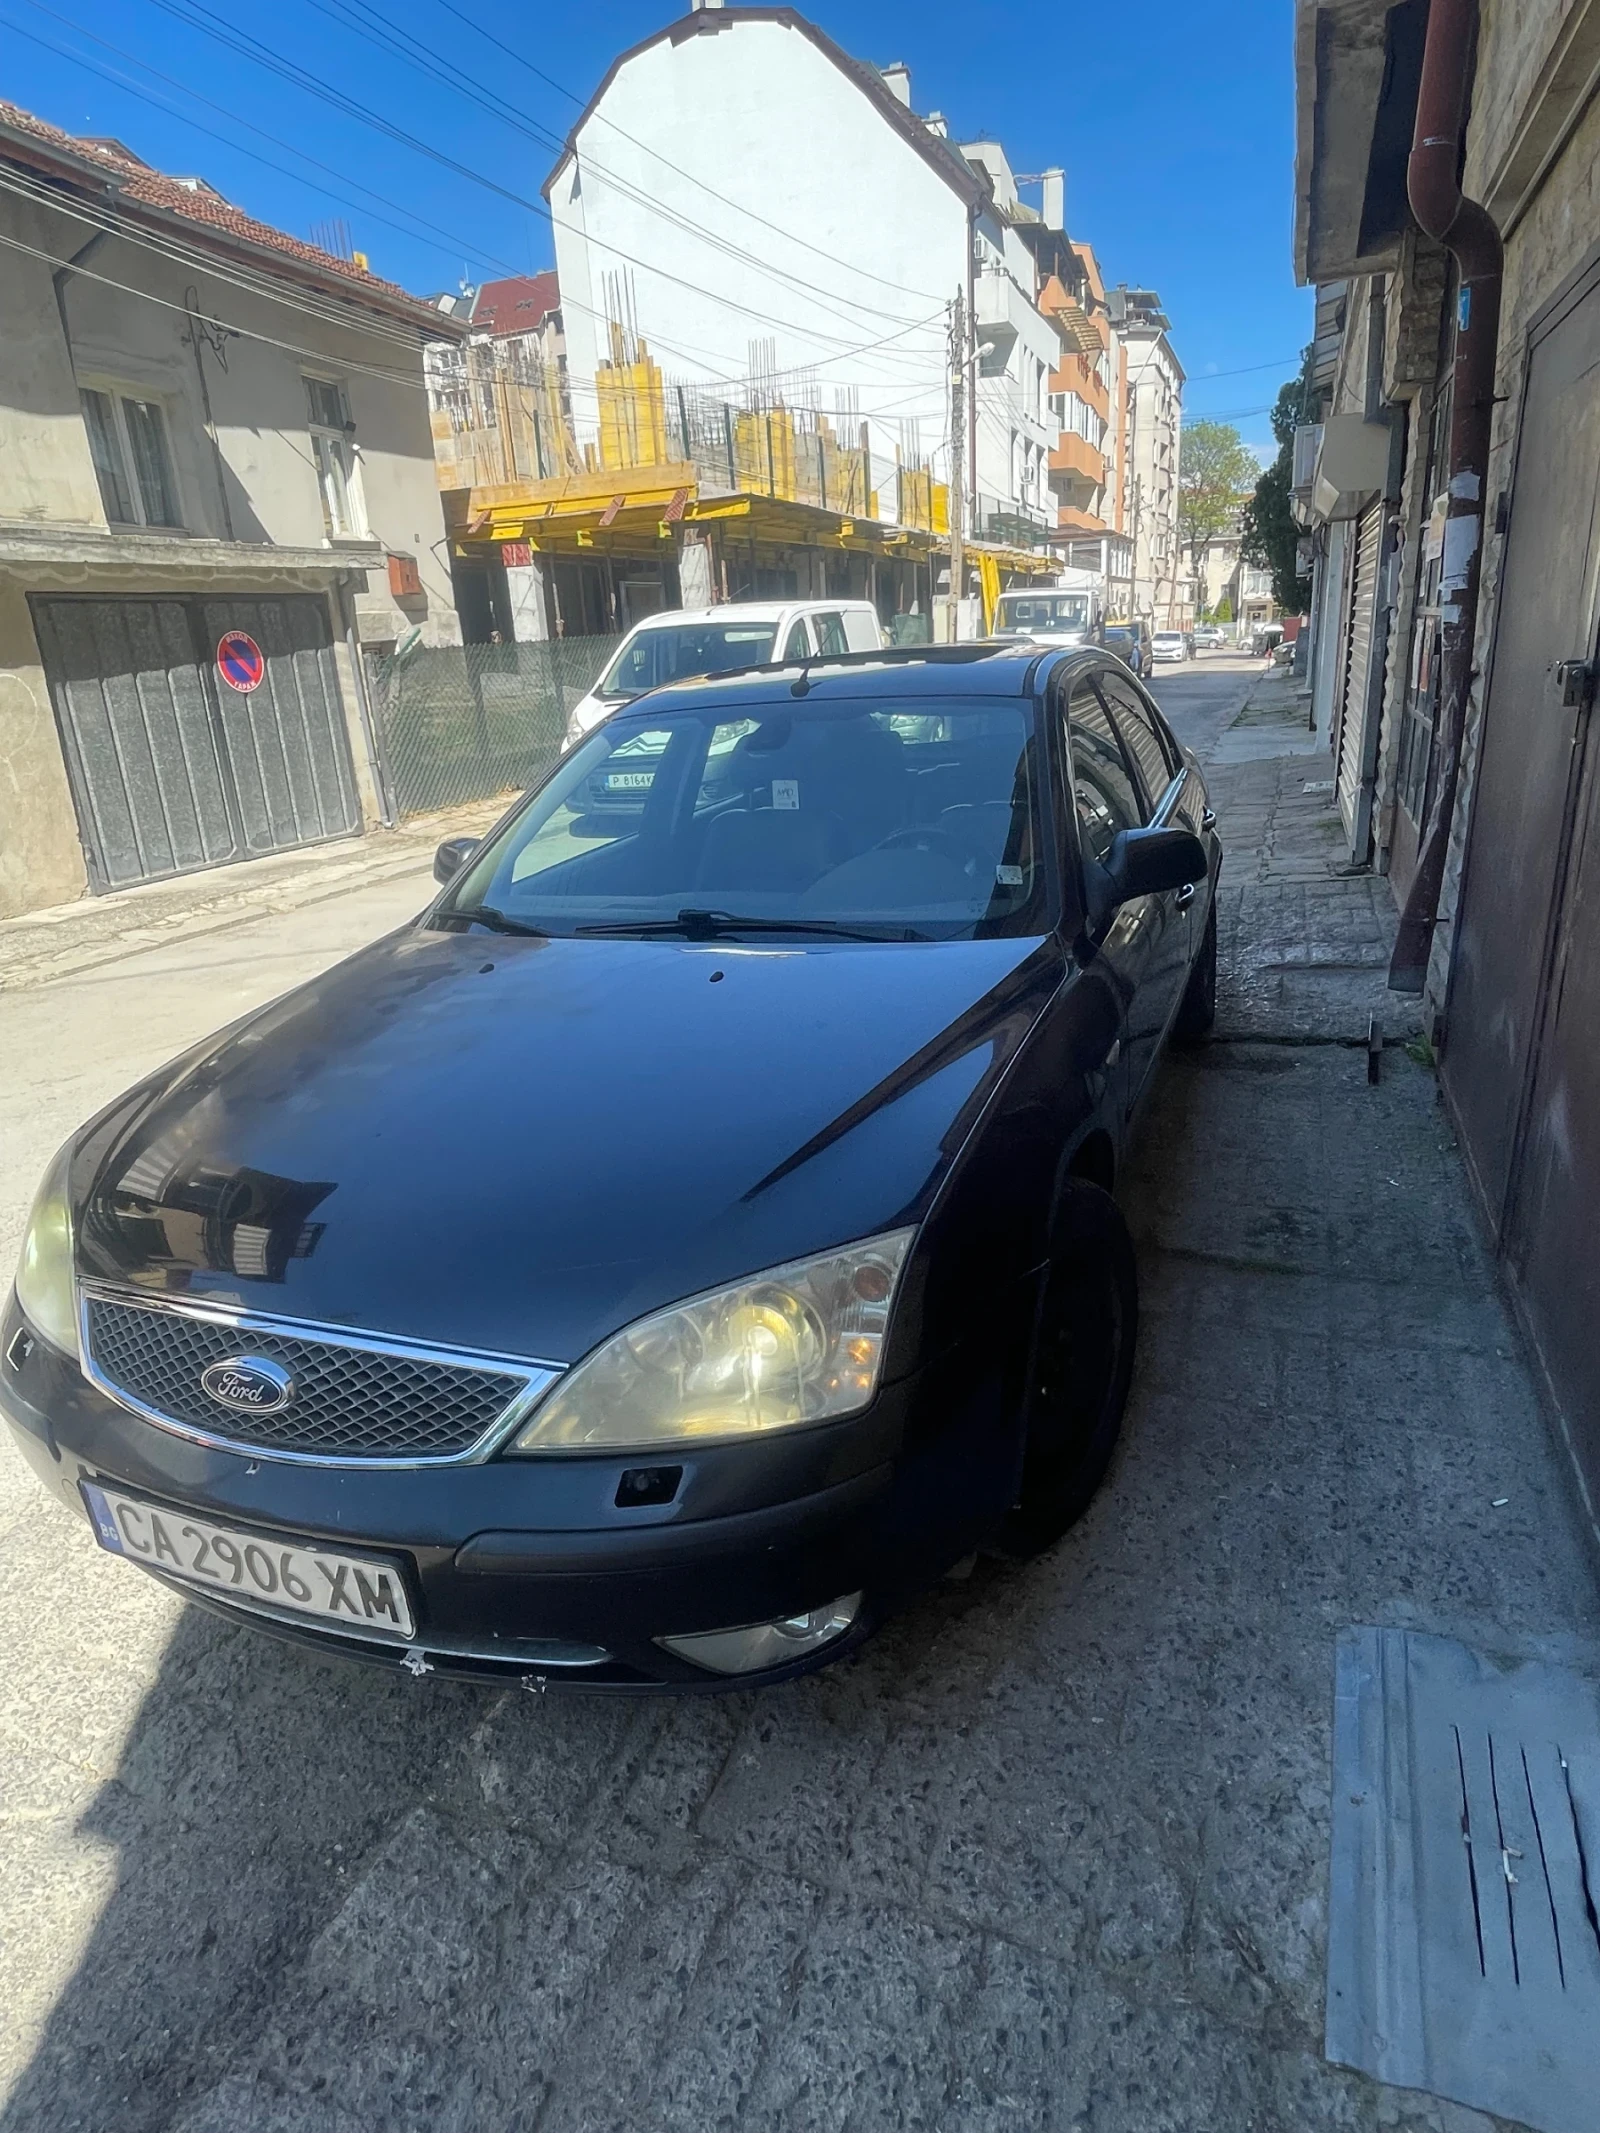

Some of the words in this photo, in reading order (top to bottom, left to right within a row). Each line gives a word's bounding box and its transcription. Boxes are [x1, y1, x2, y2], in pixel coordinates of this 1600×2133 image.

[218, 1371, 265, 1402] Ford
[100, 1522, 119, 1541] BG
[116, 1503, 183, 1567] CA
[182, 1526, 313, 1602] 2906
[315, 1560, 401, 1623] XM
